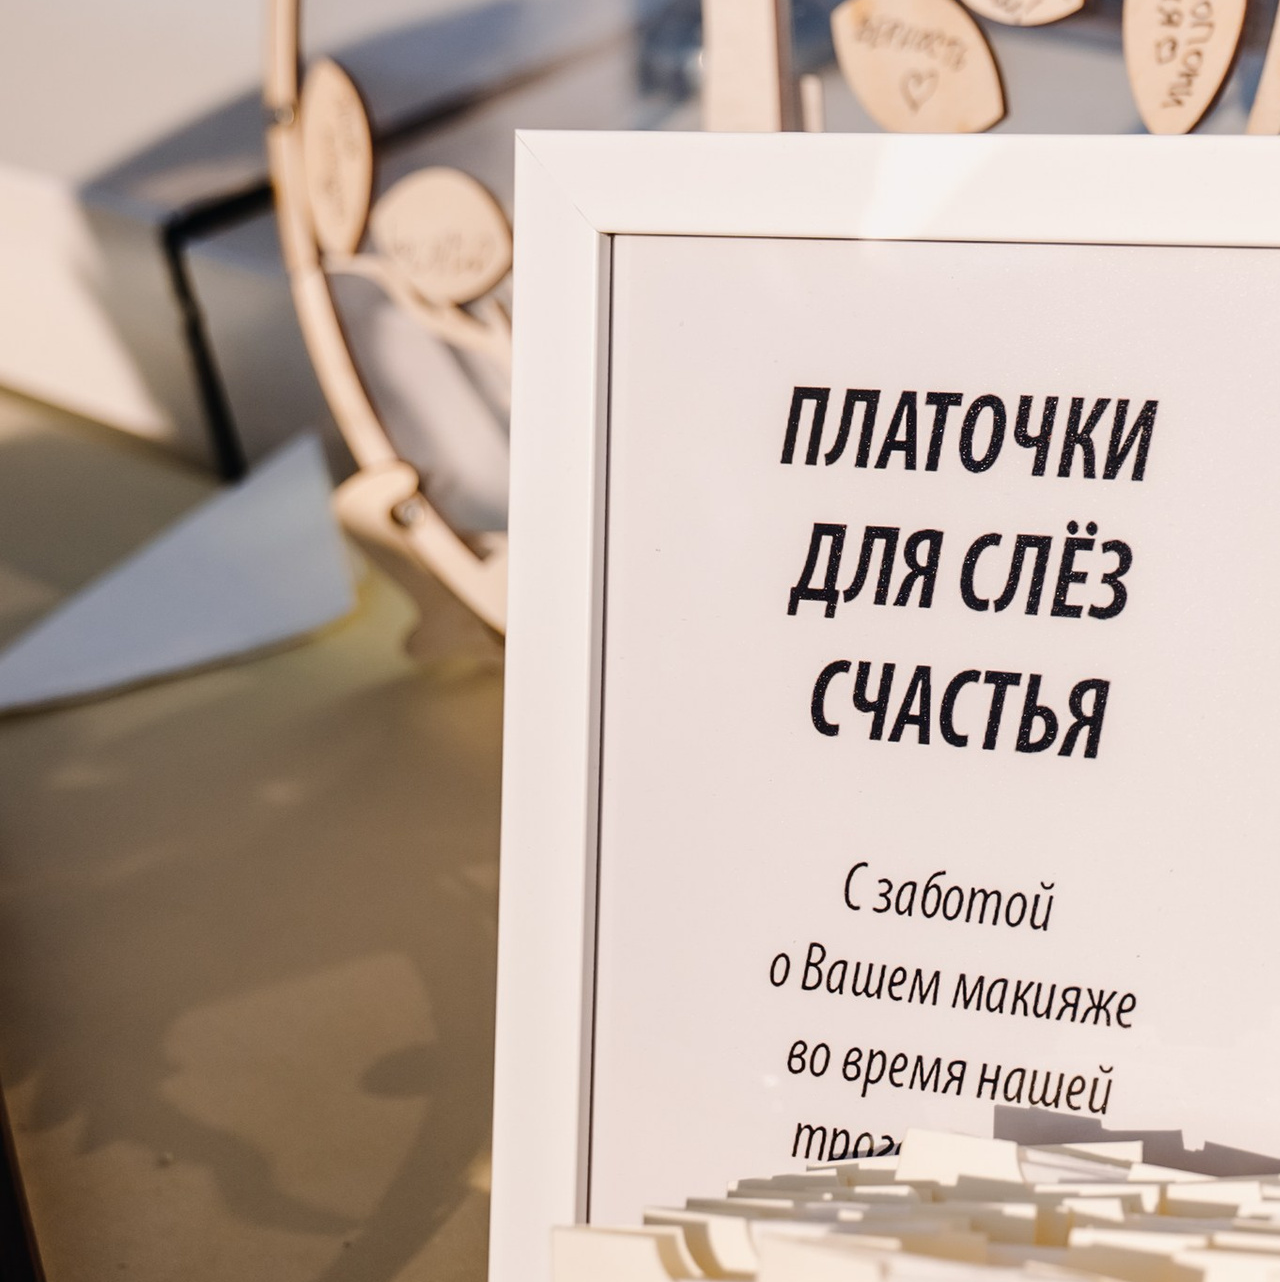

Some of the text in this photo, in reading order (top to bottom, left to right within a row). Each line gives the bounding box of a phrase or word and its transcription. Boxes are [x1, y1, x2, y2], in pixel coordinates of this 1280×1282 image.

[780, 386, 1159, 481] ПЛАТОЧКИ
[787, 520, 1133, 620] ДЛЯ СЛЁЗ
[810, 659, 1111, 759] СЧАСТЬЯ
[843, 862, 1055, 931] С заботой
[769, 942, 1137, 1029] о Вашем макияже
[786, 1040, 1114, 1115] во время нашей
